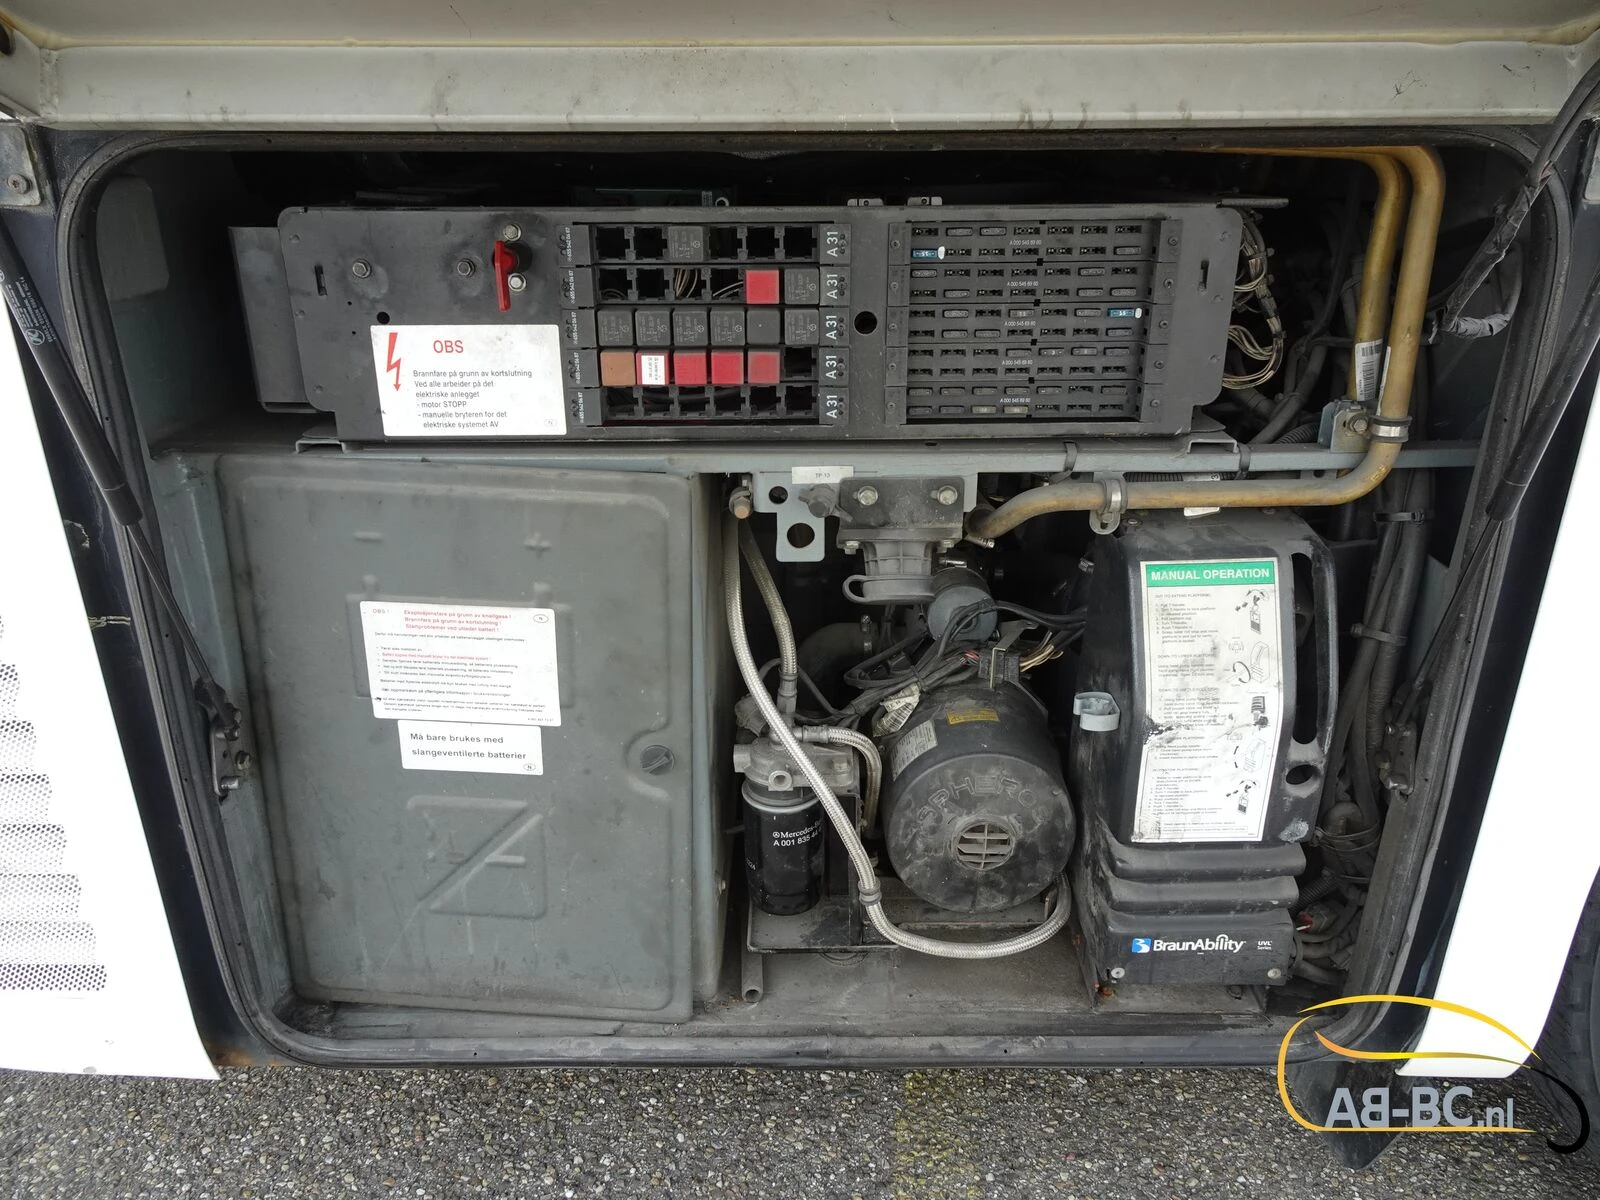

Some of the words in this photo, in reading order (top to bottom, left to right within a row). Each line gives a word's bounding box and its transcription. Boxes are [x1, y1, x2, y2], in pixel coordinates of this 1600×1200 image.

[827, 230, 838, 245] 31
[826, 272, 838, 287] 31
[826, 314, 837, 328] 31
[433, 340, 464, 353] OBS
[826, 352, 837, 367] 31
[412, 370, 447, 378] Brannfare
[448, 369, 458, 380] på
[459, 371, 479, 380] grunn
[491, 370, 532, 380] kortslutning
[472, 380, 482, 389] på
[450, 391, 480, 400] anlegget
[826, 393, 838, 408] 31
[455, 411, 483, 420] bryteren
[1151, 571, 1199, 581] MANUAL
[1203, 568, 1270, 580] OPERATION
[410, 733, 423, 741] Må
[426, 733, 447, 741] bare
[450, 735, 481, 743] brukes
[484, 736, 504, 744] med
[412, 748, 485, 758] slangeventilerte
[488, 751, 527, 760] batterier
[773, 839, 780, 847] A
[781, 838, 795, 847] 001
[797, 834, 811, 845] 835
[1153, 934, 1244, 953] BraunAbility
